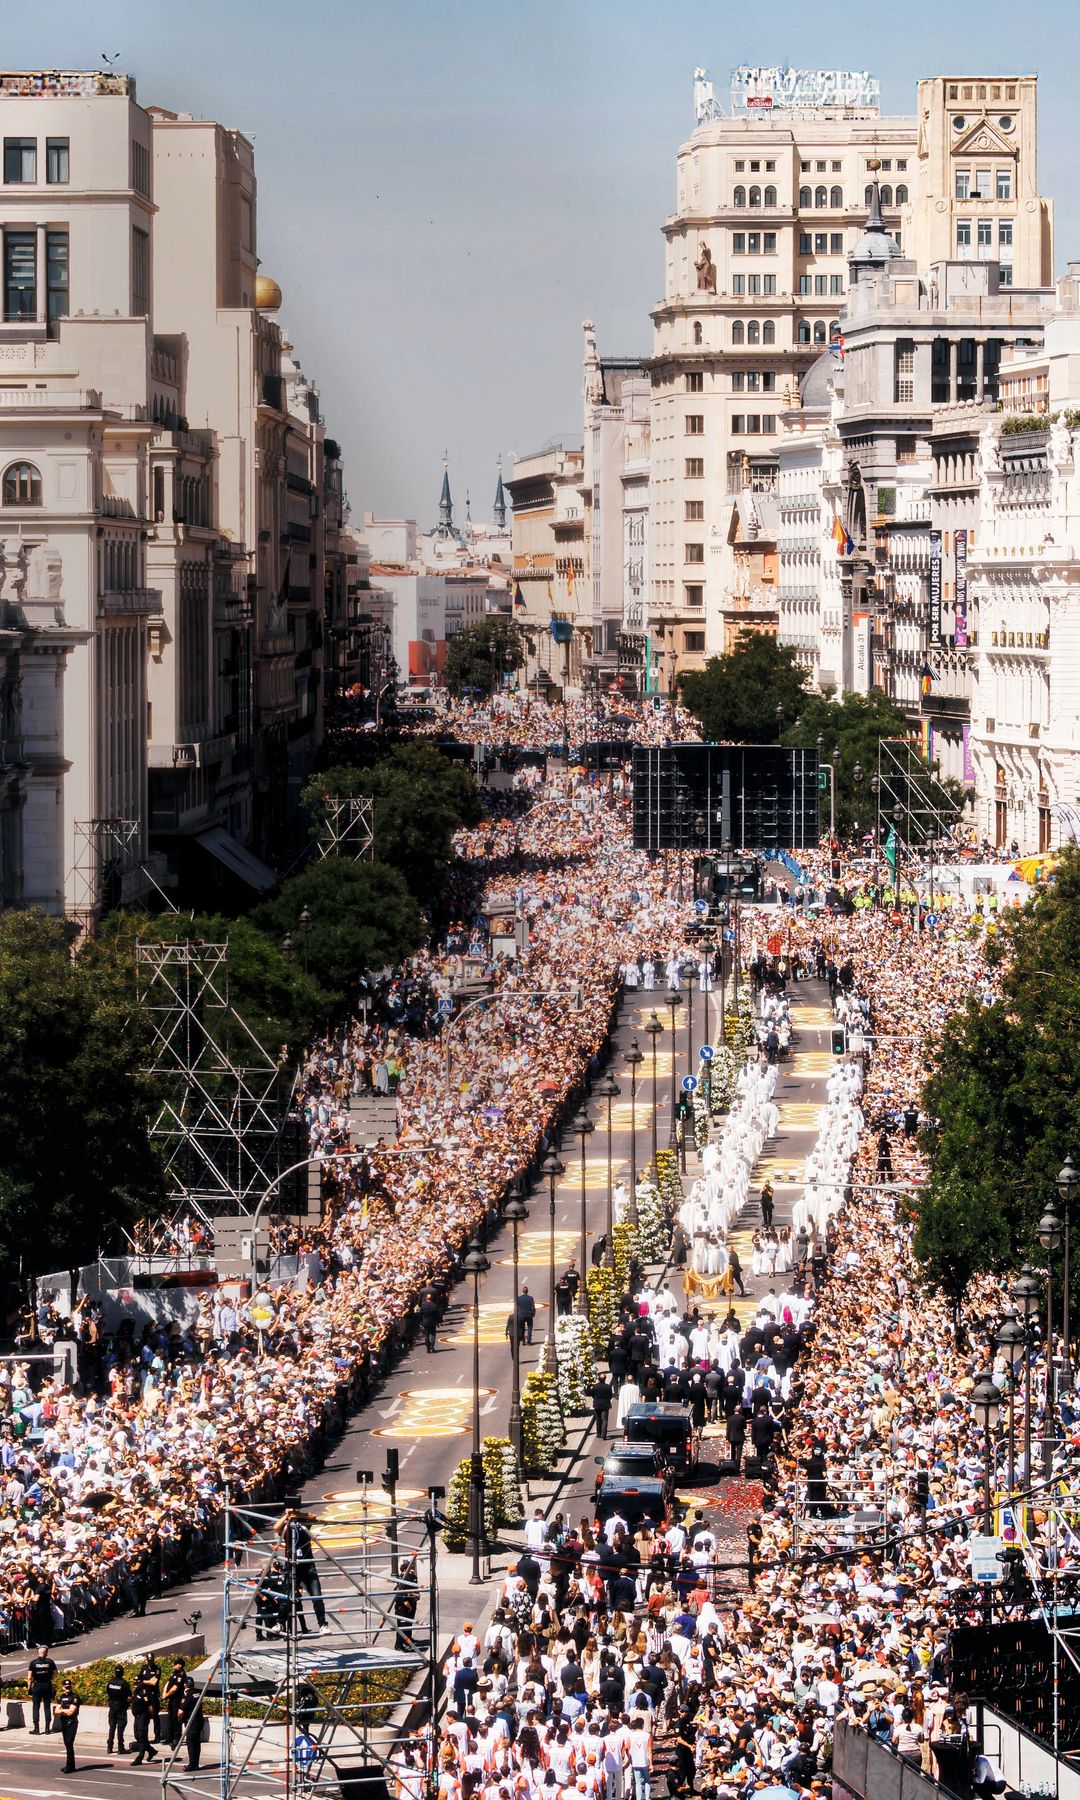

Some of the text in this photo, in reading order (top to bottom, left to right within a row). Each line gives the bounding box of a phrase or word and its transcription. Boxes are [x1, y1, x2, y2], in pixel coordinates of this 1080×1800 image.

[956, 541, 965, 558] VIVAS
[932, 559, 940, 642] POR SER MUJERES
[956, 590, 965, 603] NOS
[858, 633, 865, 643] 31
[857, 645, 865, 670] Alcalá
